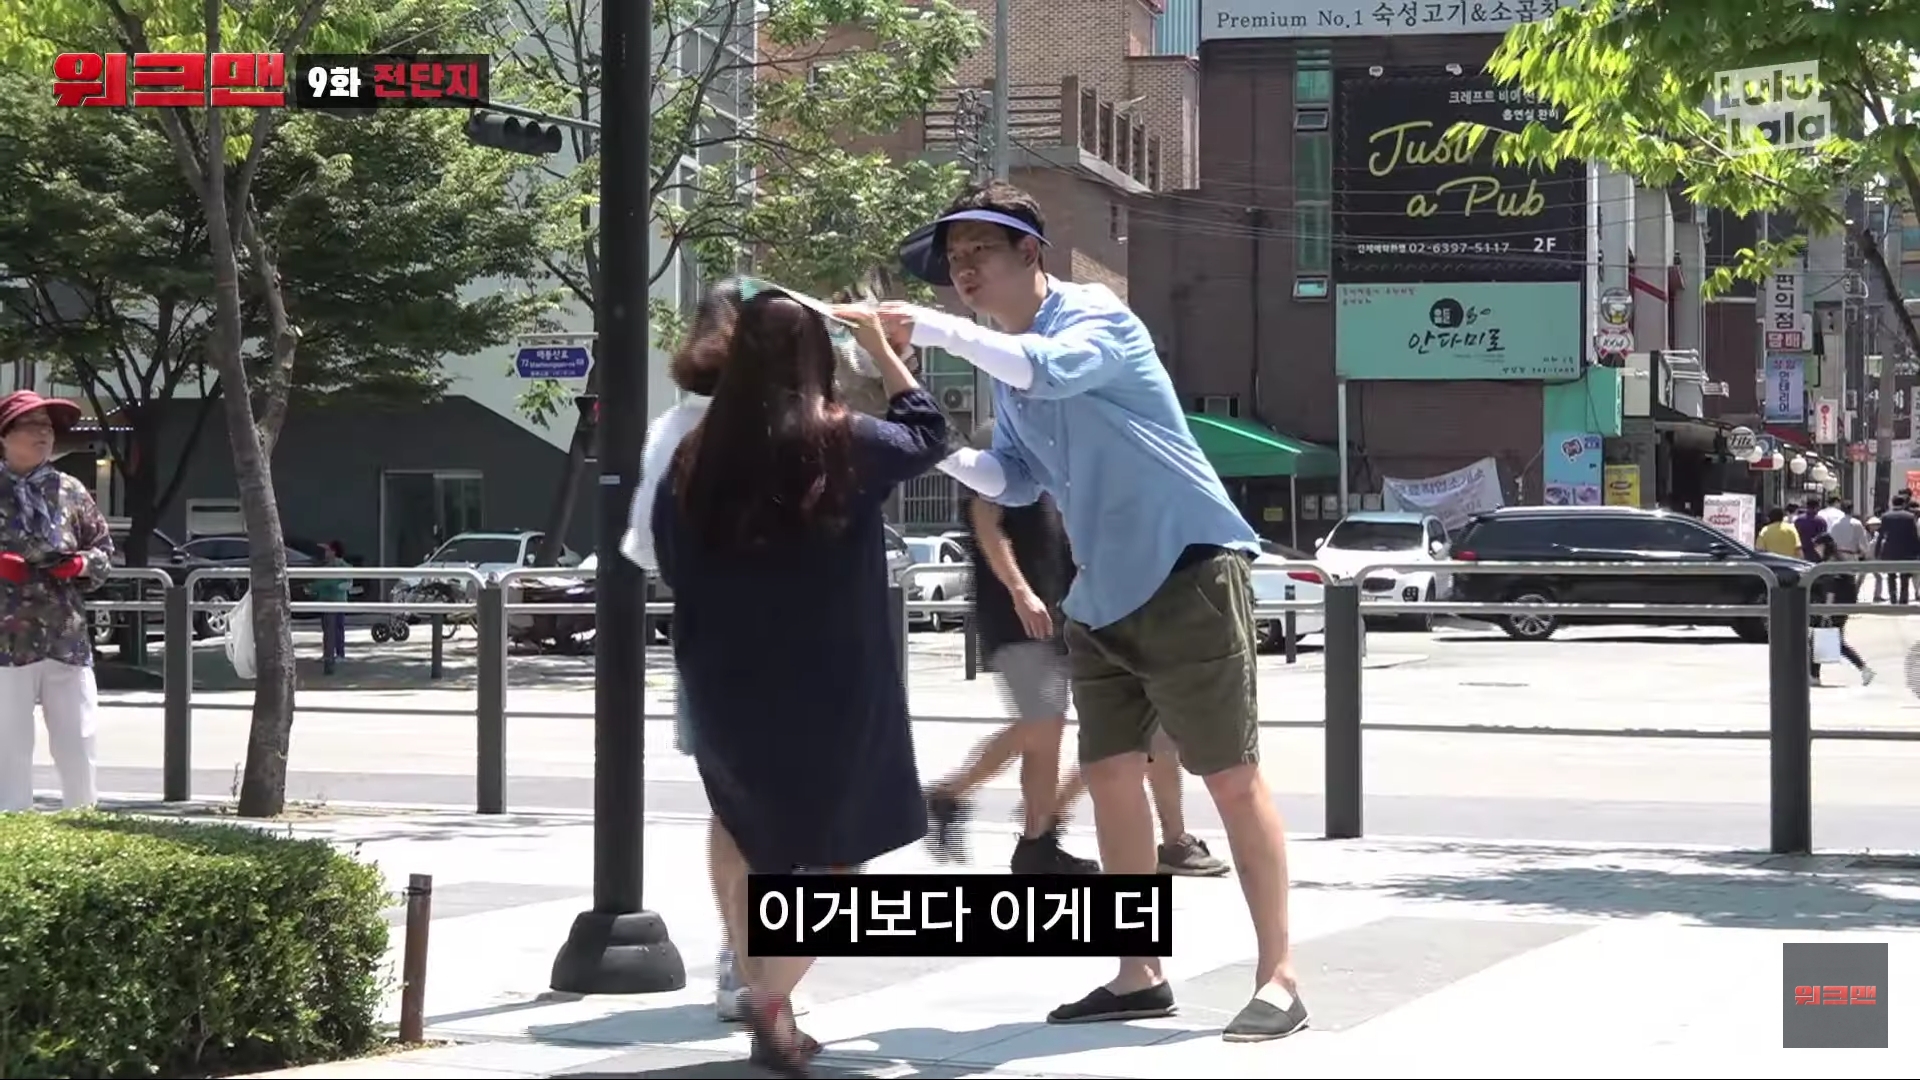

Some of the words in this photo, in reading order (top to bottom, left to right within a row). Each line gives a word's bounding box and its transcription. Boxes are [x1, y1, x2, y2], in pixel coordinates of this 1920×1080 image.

[1217, 10, 1307, 29] Premium
[1317, 10, 1364, 29] No.1
[1405, 194, 1438, 218] a
[1436, 175, 1546, 217] Pub
[1409, 242, 1510, 254] 02-6397-5117
[1533, 237, 1557, 253] 2F
[1774, 274, 1795, 330] 편의점
[1779, 370, 1790, 412] 인테리어
